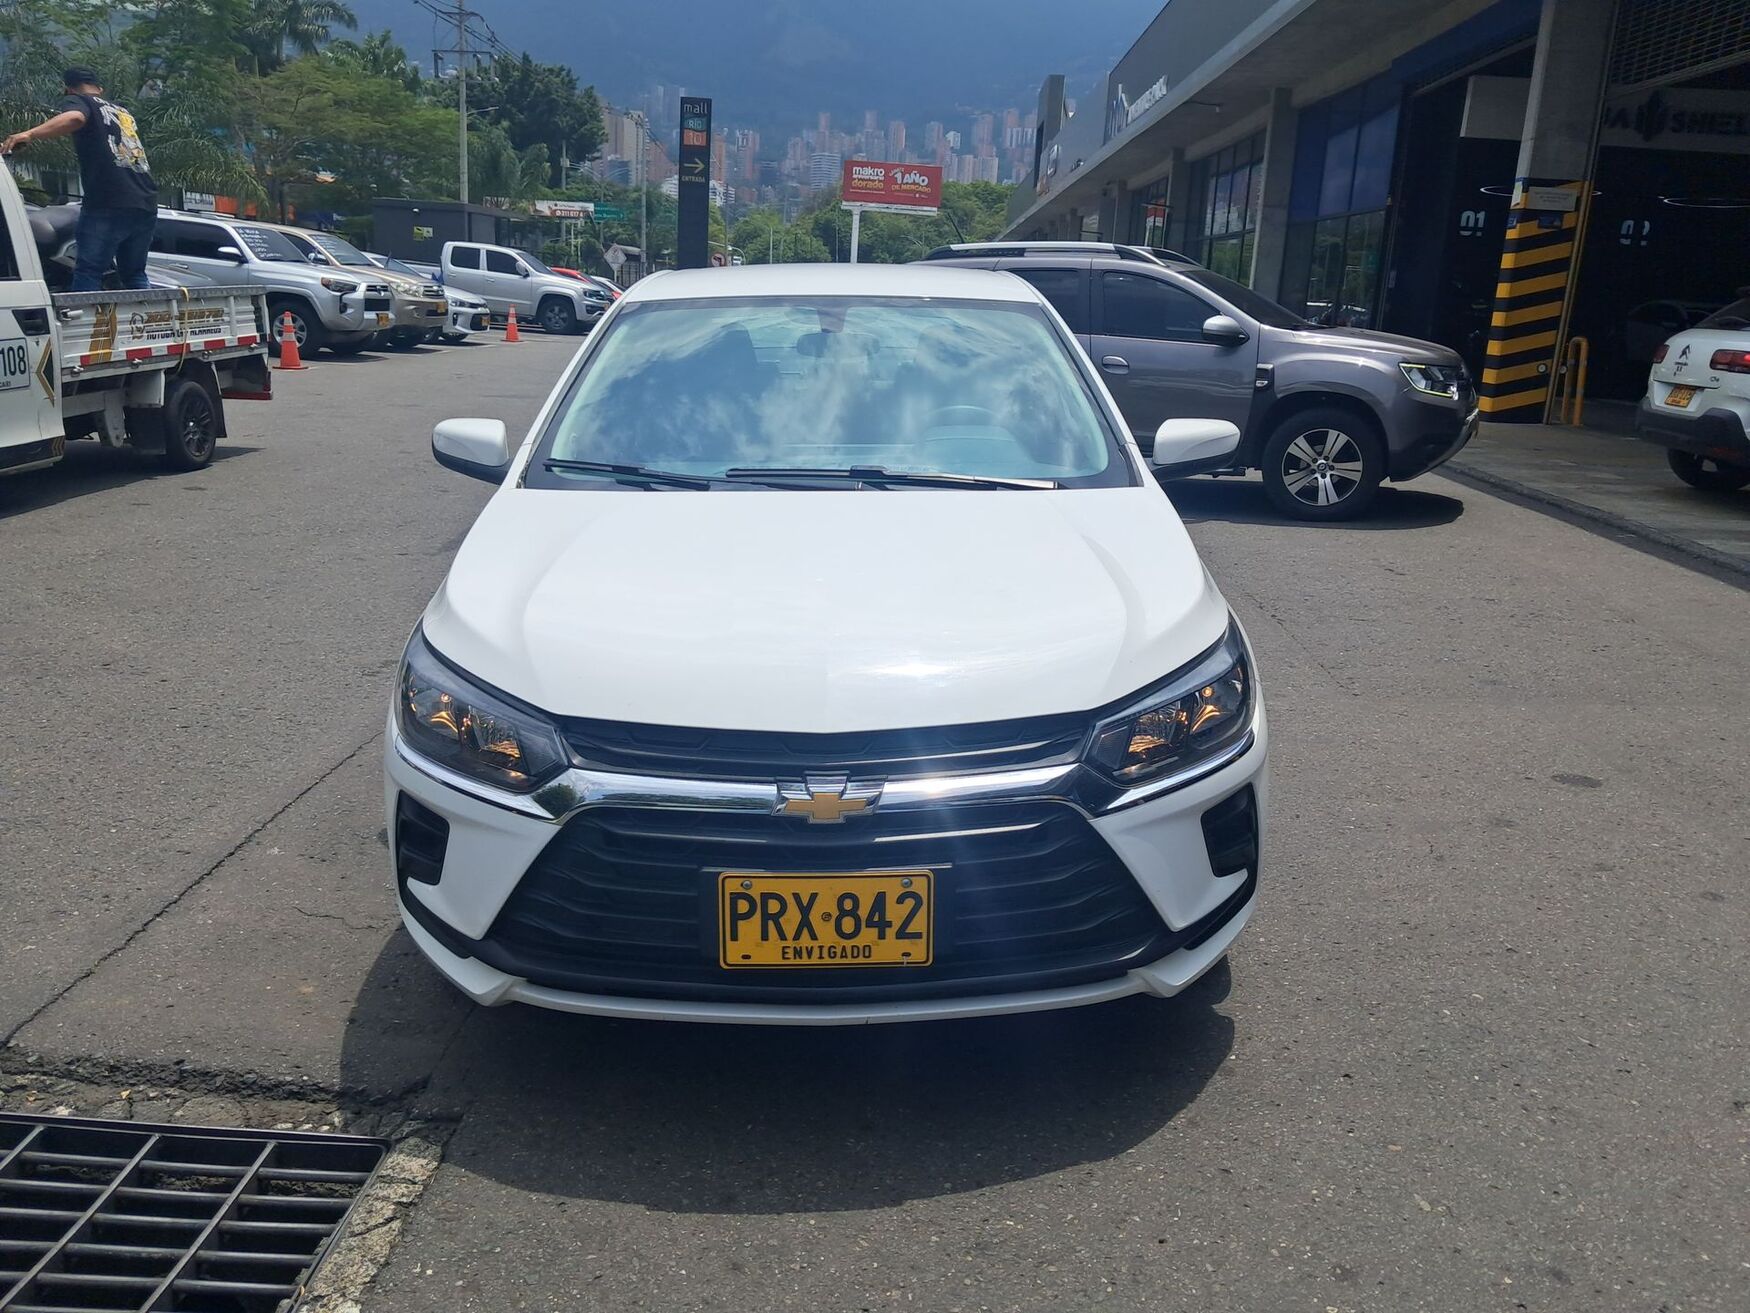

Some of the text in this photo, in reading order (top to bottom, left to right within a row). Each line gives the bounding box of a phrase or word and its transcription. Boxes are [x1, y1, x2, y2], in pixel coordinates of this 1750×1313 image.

[683, 102, 708, 114] mall
[852, 166, 885, 177] makro
[681, 175, 706, 184] ENTRADA
[851, 179, 884, 189] dorado
[894, 171, 903, 184] 1
[903, 171, 929, 186] AÑO
[901, 184, 932, 193] MERCADO
[729, 891, 923, 942] PRX 842
[782, 944, 872, 960] ENVIGADO
